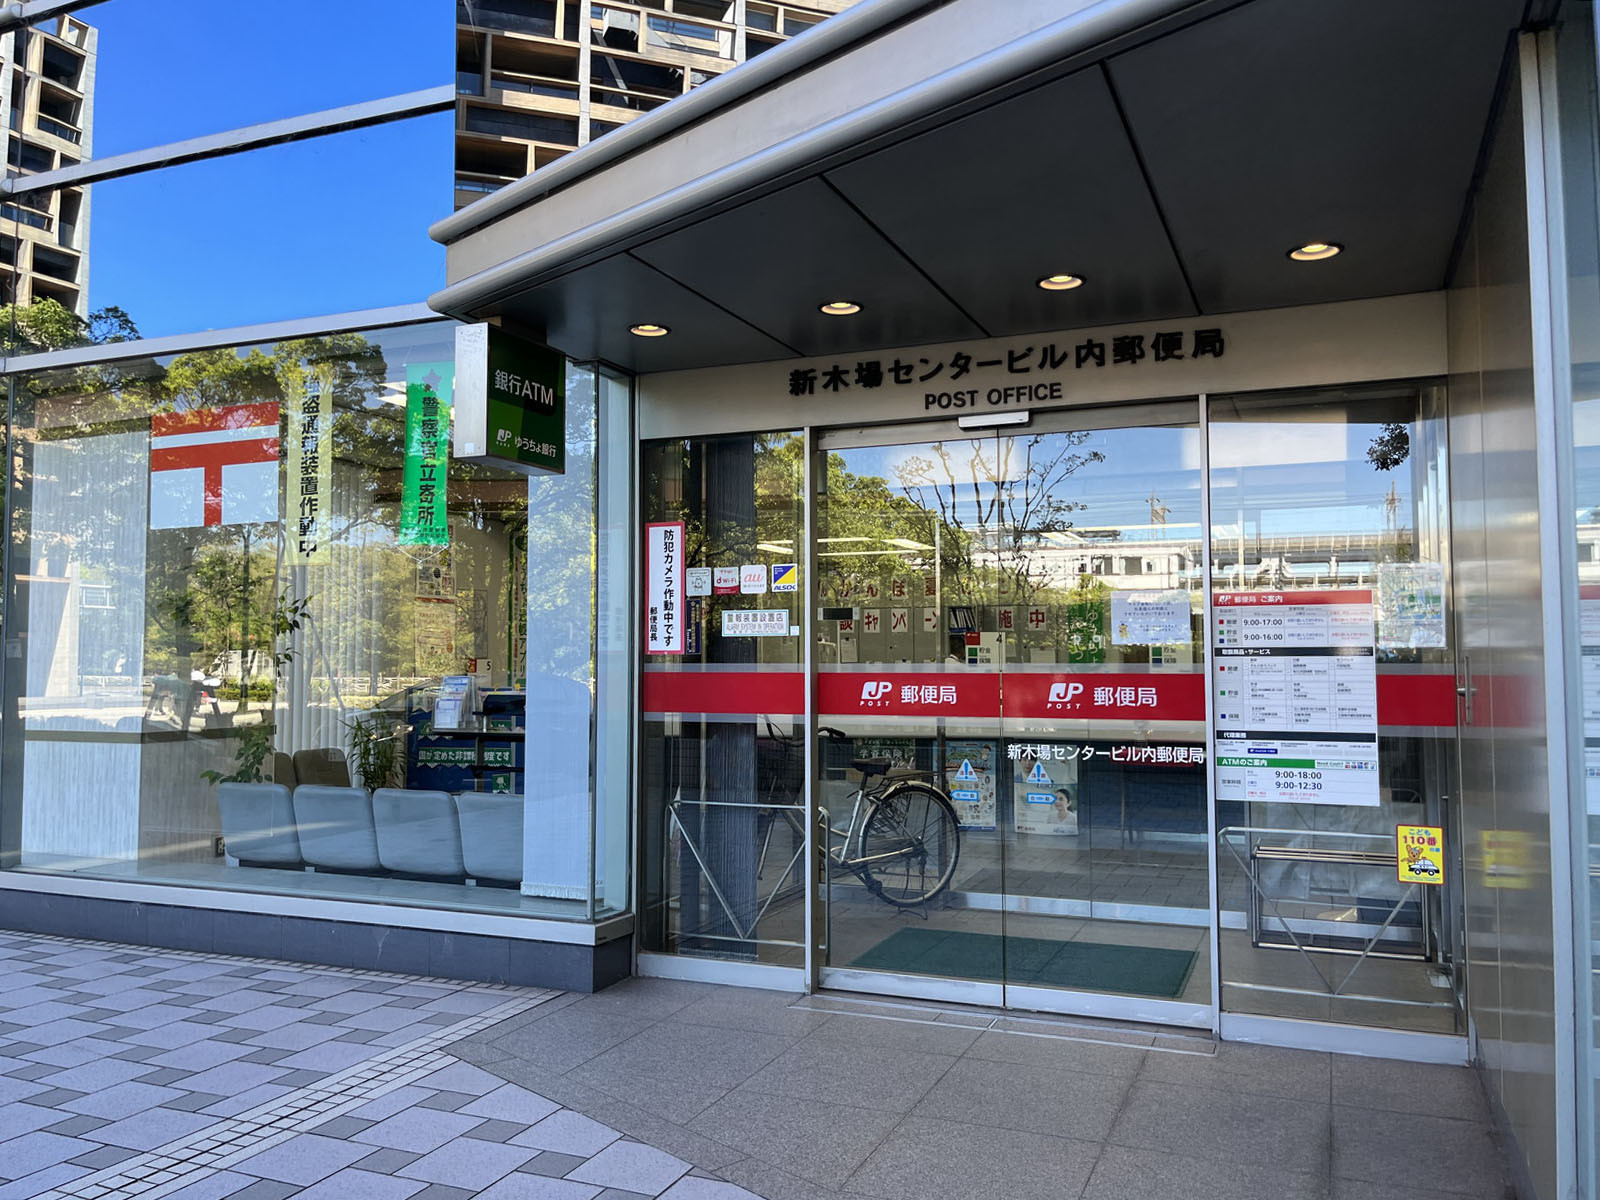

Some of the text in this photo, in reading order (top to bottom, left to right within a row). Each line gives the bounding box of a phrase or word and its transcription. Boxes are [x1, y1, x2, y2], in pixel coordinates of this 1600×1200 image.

[788, 328, 1225, 396] 新木場センタービル内郵便局
[494, 369, 554, 407] 銀行ATM
[924, 382, 1063, 410] POST OFFICE
[514, 436, 557, 458] ゆうちょ銀行
[417, 396, 439, 526] 警察官立寄所
[663, 529, 675, 647] 防犯カメラ作動中です
[743, 572, 763, 583] au
[1260, 595, 1283, 603] ご案内
[649, 606, 658, 642] 郵便局長
[901, 685, 957, 704] 郵便局
[1093, 686, 1158, 708] 郵便局
[1007, 743, 1205, 764] 新木場センタービル内郵便局
[1222, 758, 1267, 766] ATMのご案内
[1275, 770, 1322, 779] 9:00-18:00
[1275, 781, 1322, 790] 9:00-12:30
[1403, 835, 1437, 846] 110番
